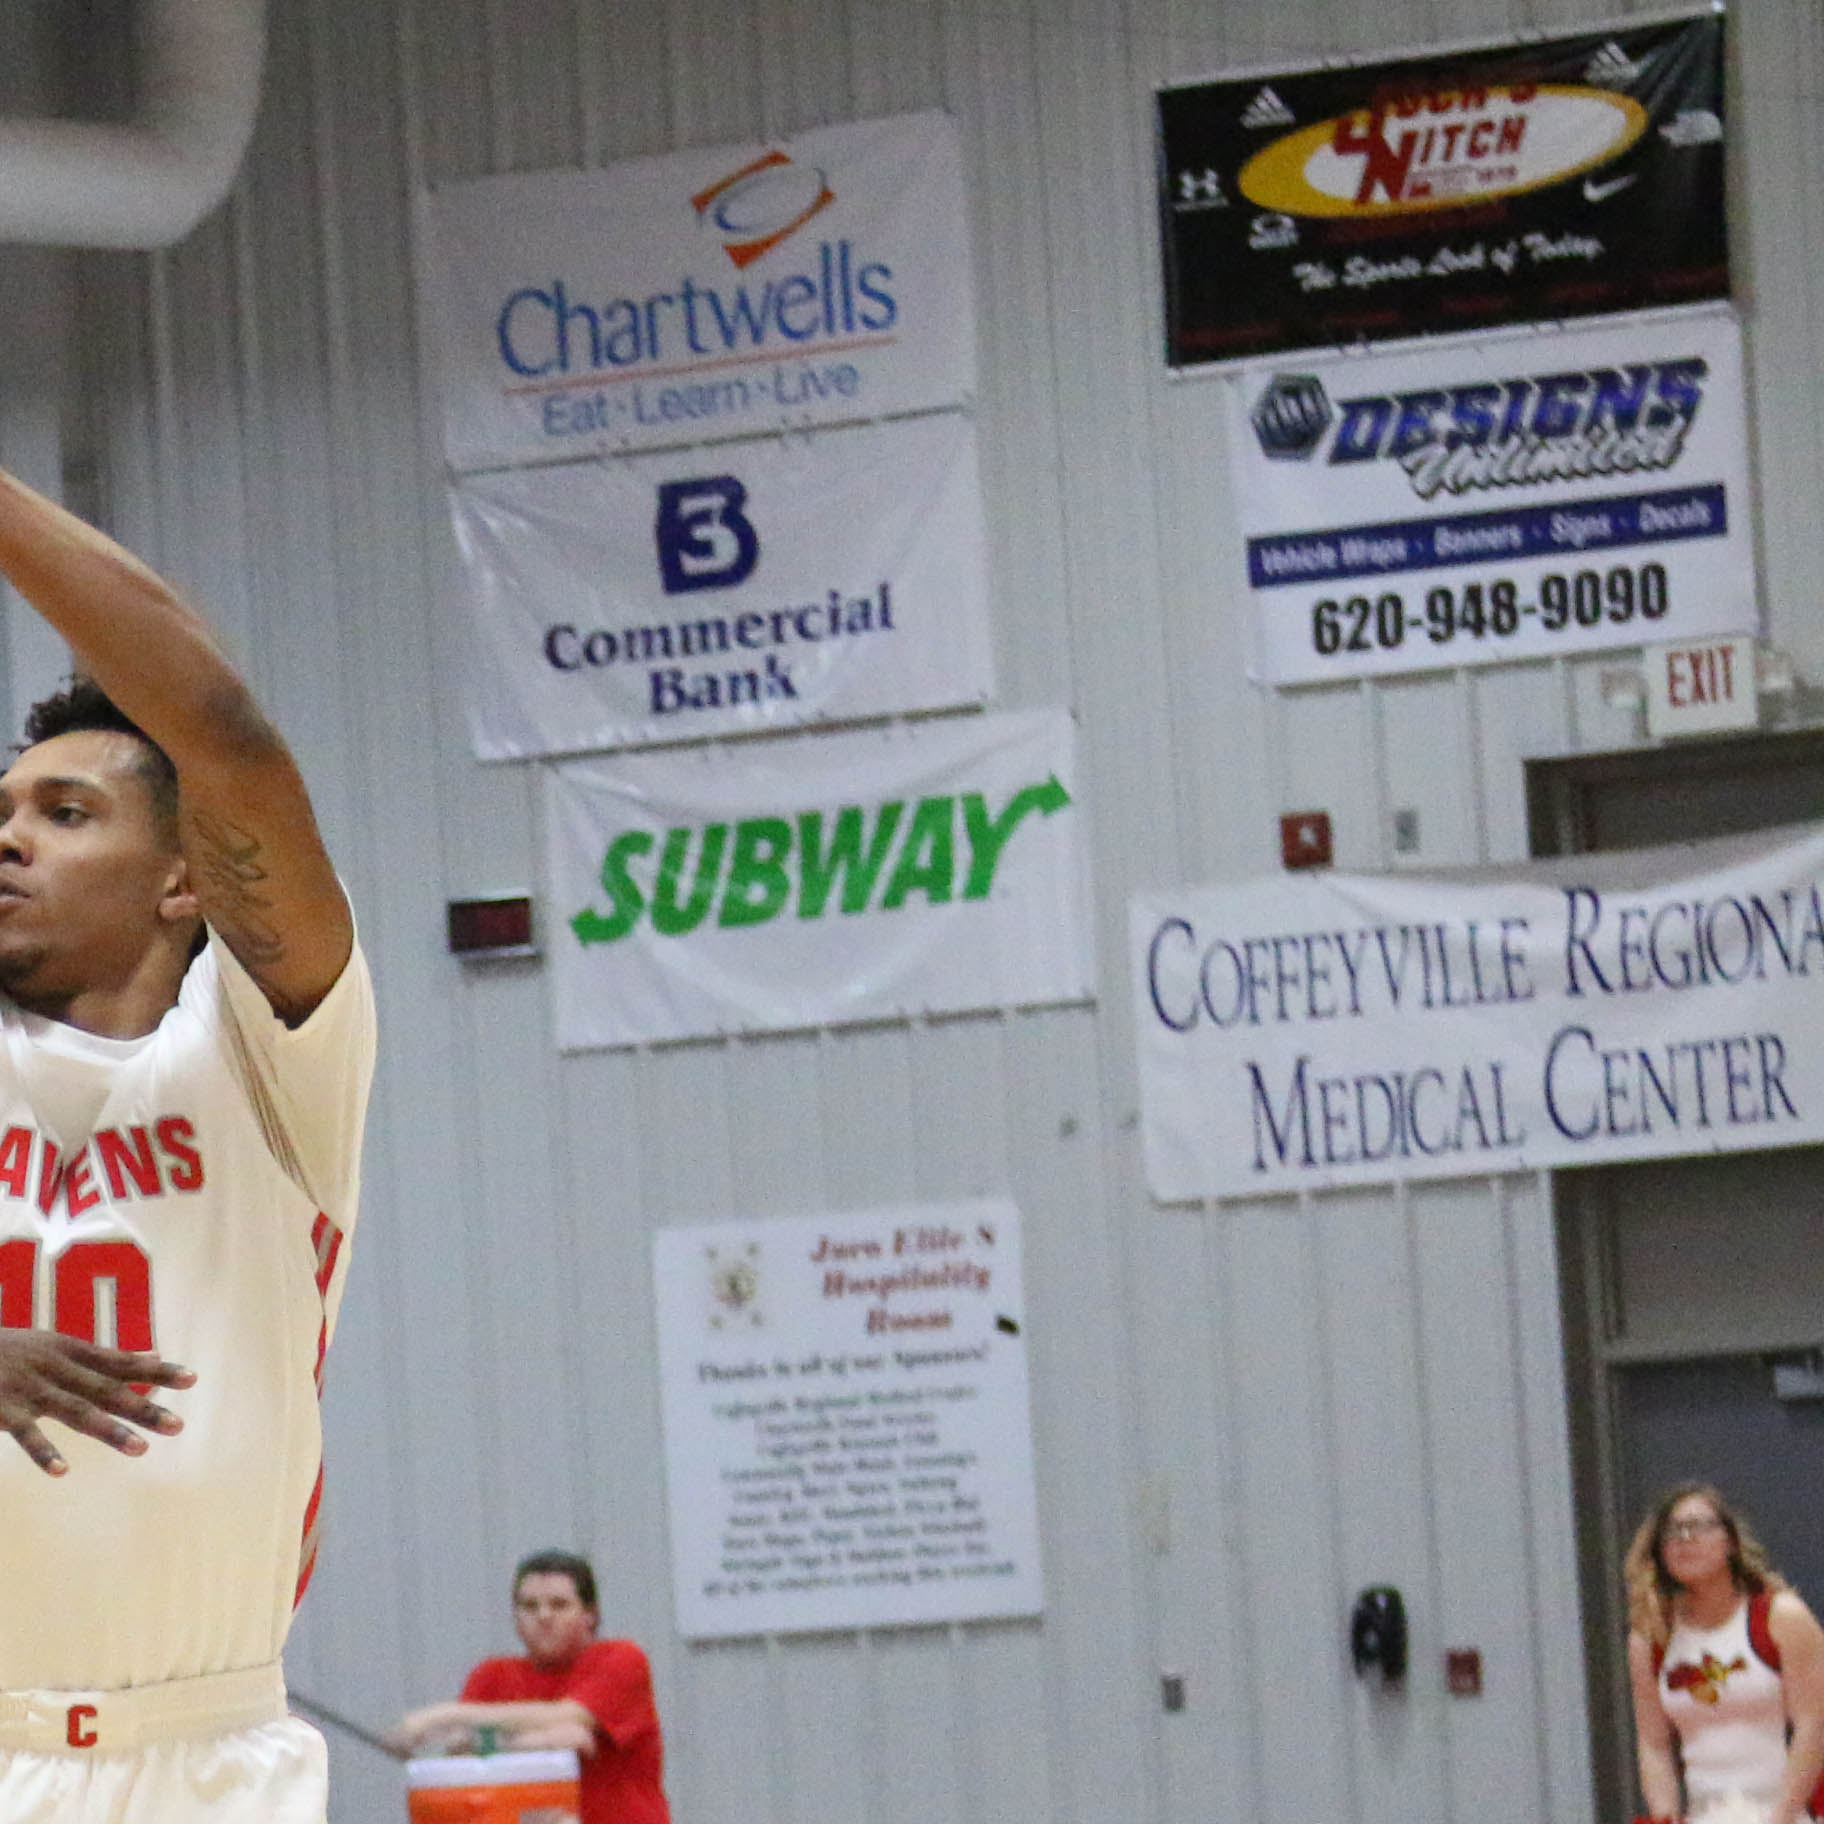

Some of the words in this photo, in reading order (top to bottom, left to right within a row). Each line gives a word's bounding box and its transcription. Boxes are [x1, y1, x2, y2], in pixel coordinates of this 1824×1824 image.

[498, 240, 899, 378] Chartwells
[542, 394, 609, 437] Eat
[773, 362, 861, 404] Live
[1327, 356, 1708, 465] DESIGNS
[1434, 524, 1523, 557] Banners
[1550, 512, 1613, 547] Signs
[1639, 499, 1712, 533] Decals
[544, 583, 896, 671] Commercial
[1311, 561, 1669, 656] 620-948-9090
[650, 655, 799, 716] Bank
[1666, 643, 1735, 708] EXIT
[570, 770, 1071, 948] SUBWAY
[1148, 916, 1537, 1034] COFFEYVILLE
[1246, 1053, 1526, 1176] MEDICAL
[1543, 1024, 1800, 1144] CENTER
[66, 1704, 98, 1748] C
